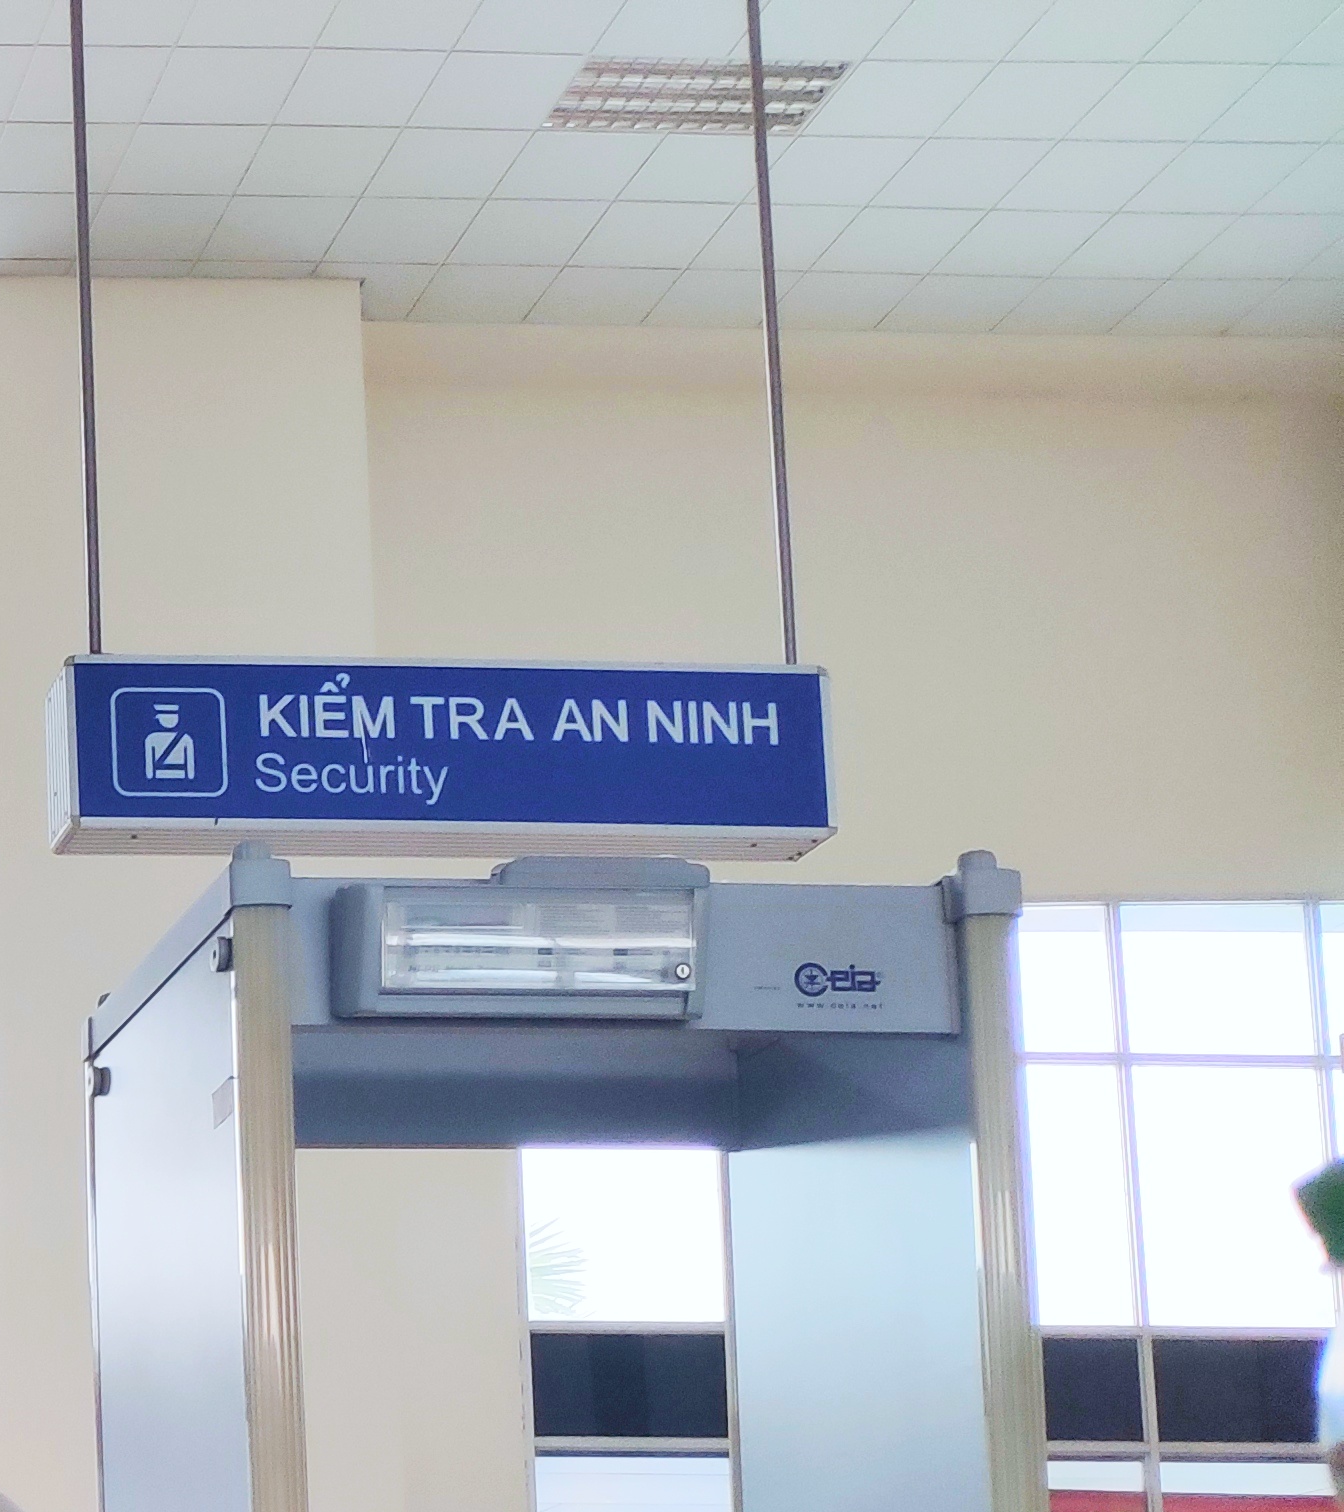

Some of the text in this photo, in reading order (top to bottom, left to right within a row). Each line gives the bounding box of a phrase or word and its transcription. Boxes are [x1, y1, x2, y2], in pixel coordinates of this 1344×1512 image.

[258, 672, 780, 745] KIỂM TRA AN NINH
[254, 752, 449, 806] Security
